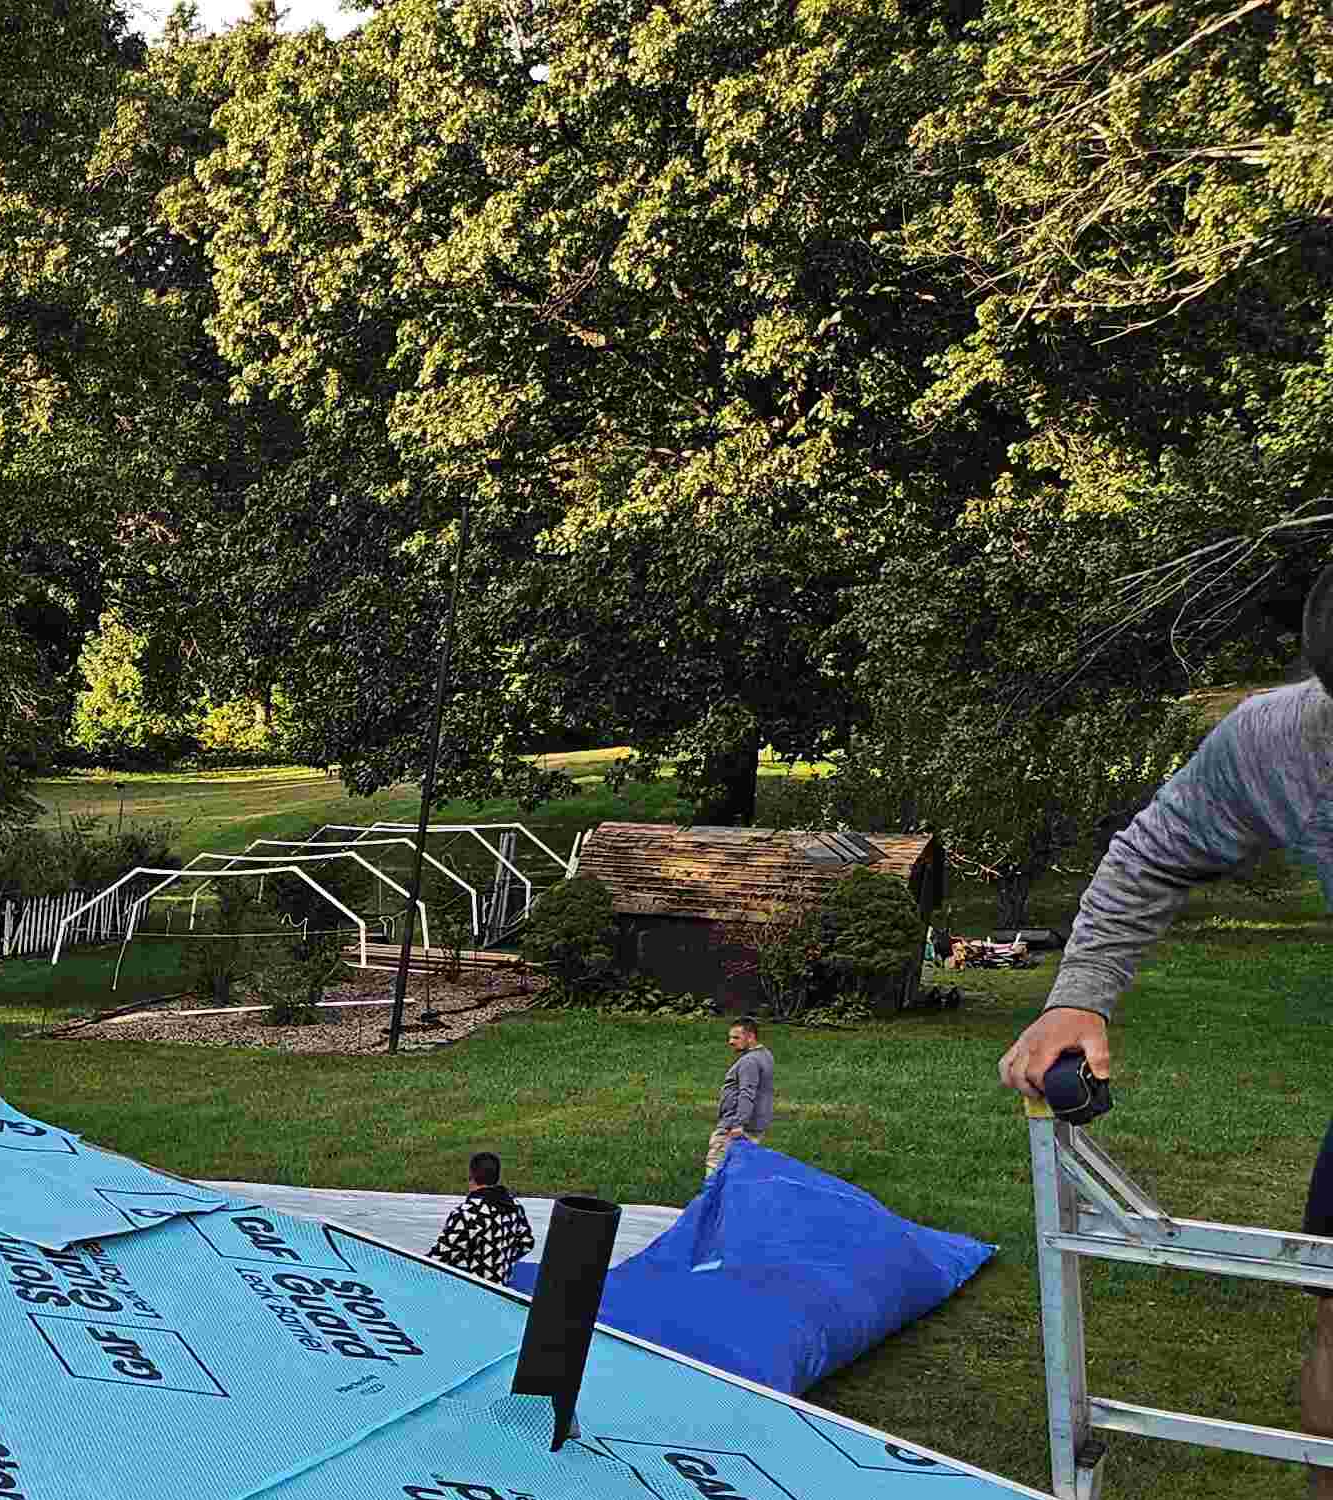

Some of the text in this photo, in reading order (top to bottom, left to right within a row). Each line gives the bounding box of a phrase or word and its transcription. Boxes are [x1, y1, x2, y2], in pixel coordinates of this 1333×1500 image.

[231, 1217, 301, 1261] GAF
[235, 1267, 330, 1354] Leak Barrier
[272, 1273, 393, 1360] Guard
[320, 1278, 424, 1355] Storm
[85, 1327, 162, 1380] GAF
